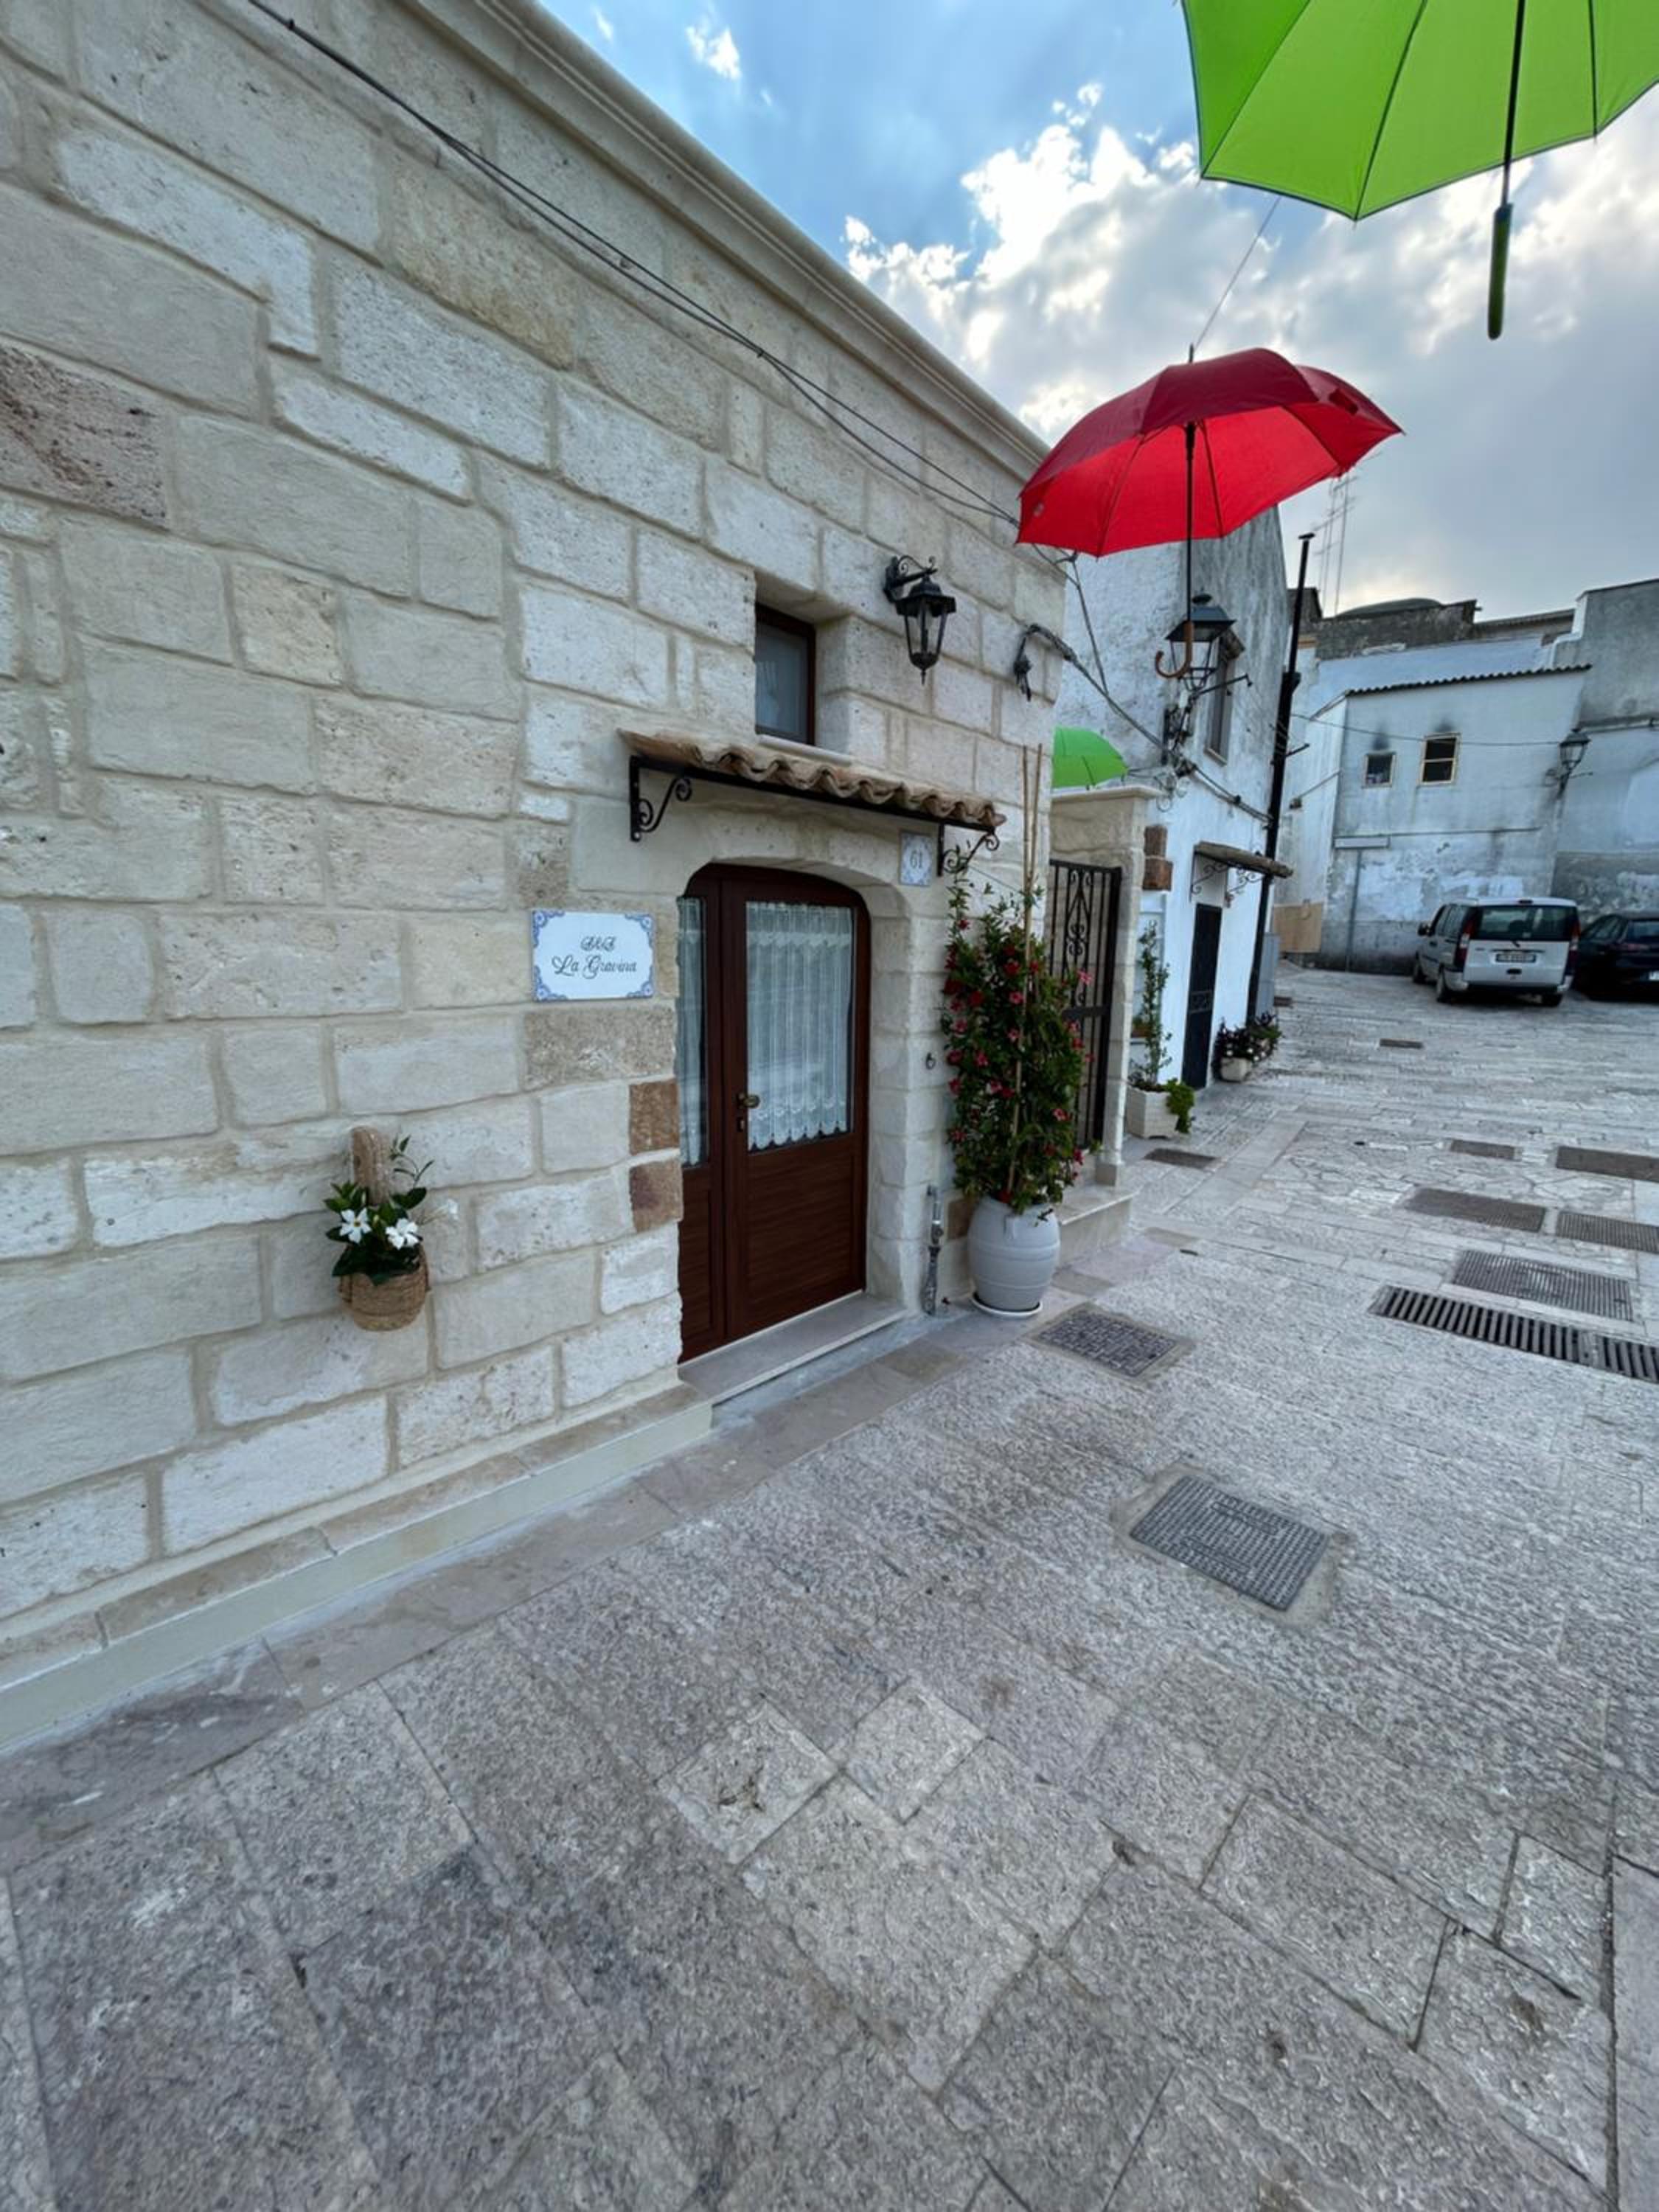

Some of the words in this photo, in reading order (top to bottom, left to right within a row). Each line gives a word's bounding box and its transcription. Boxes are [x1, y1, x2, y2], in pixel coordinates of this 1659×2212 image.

[910, 849, 923, 869] 61
[552, 954, 580, 977] La
[582, 954, 638, 980] Gravina
